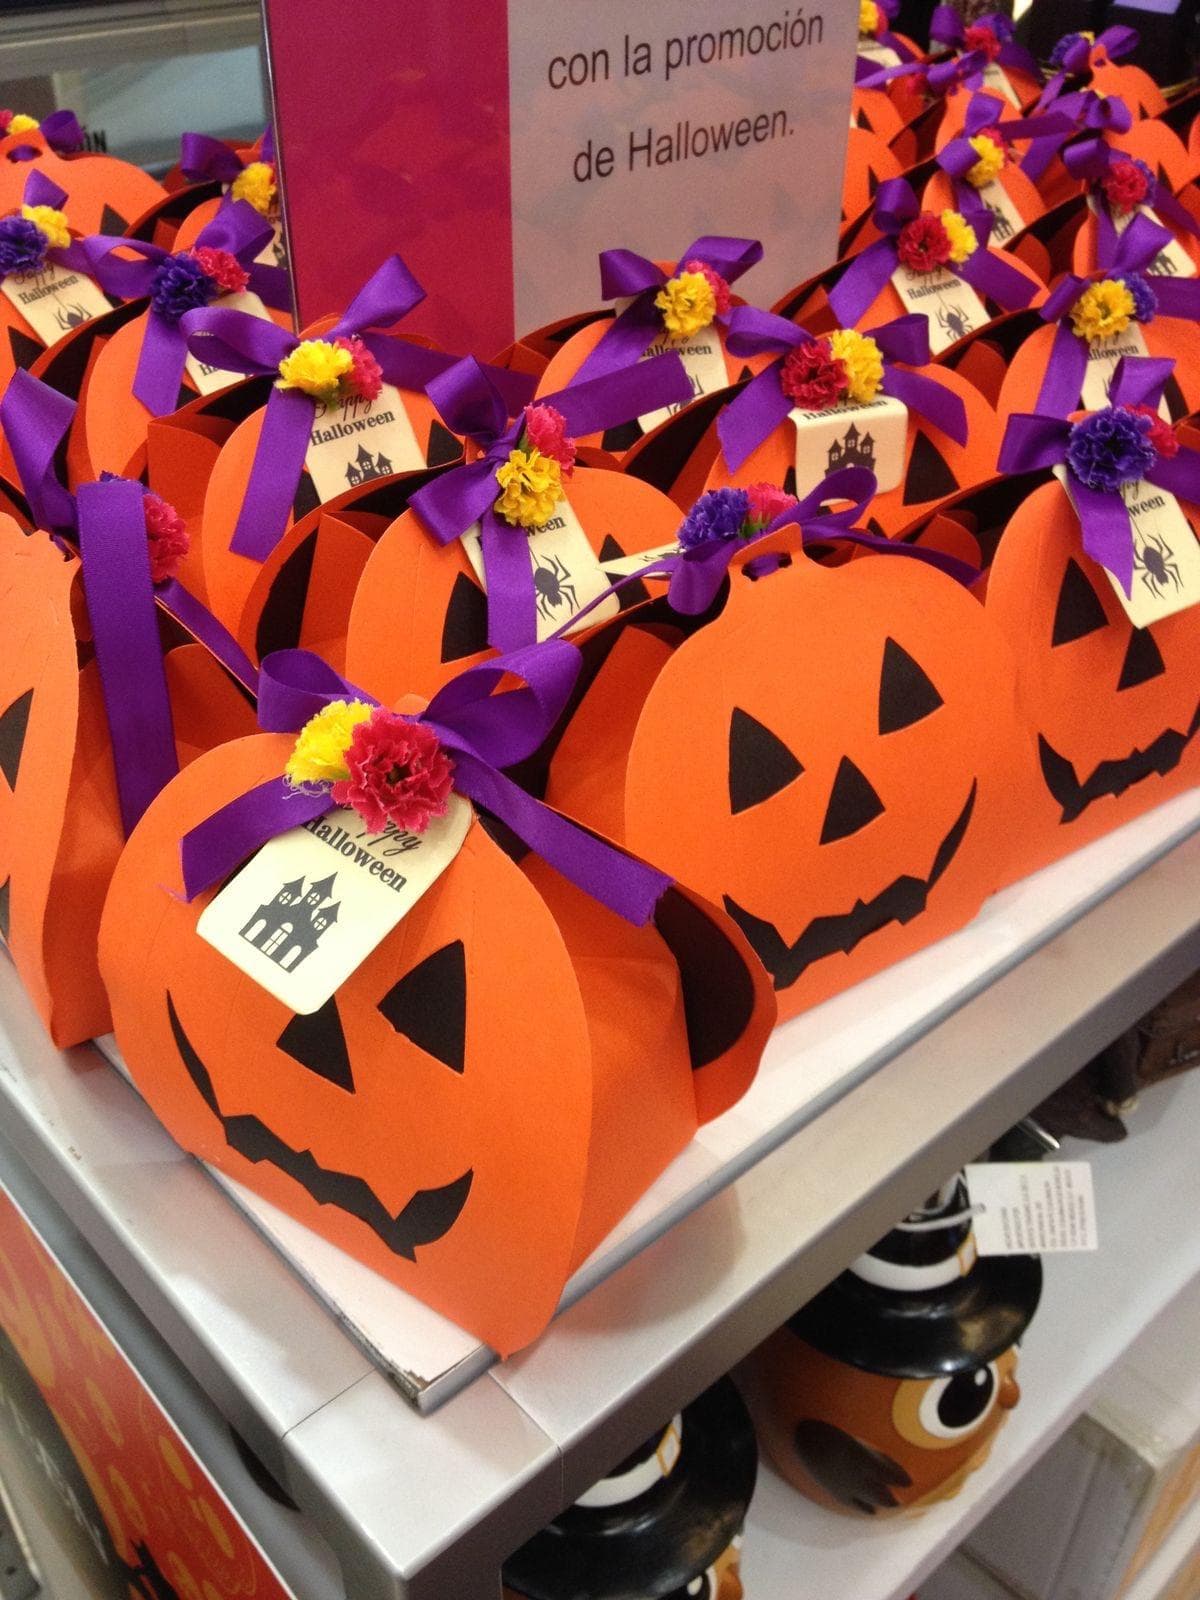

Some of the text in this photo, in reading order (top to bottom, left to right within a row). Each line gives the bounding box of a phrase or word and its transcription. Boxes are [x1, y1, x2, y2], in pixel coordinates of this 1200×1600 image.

[549, 8, 824, 90] con la promoción
[573, 109, 795, 183] de Halloween.
[17, 274, 79, 304] Halloween
[907, 278, 961, 300] Halloween
[309, 411, 396, 447] Halloween
[302, 815, 408, 893] Halloween
